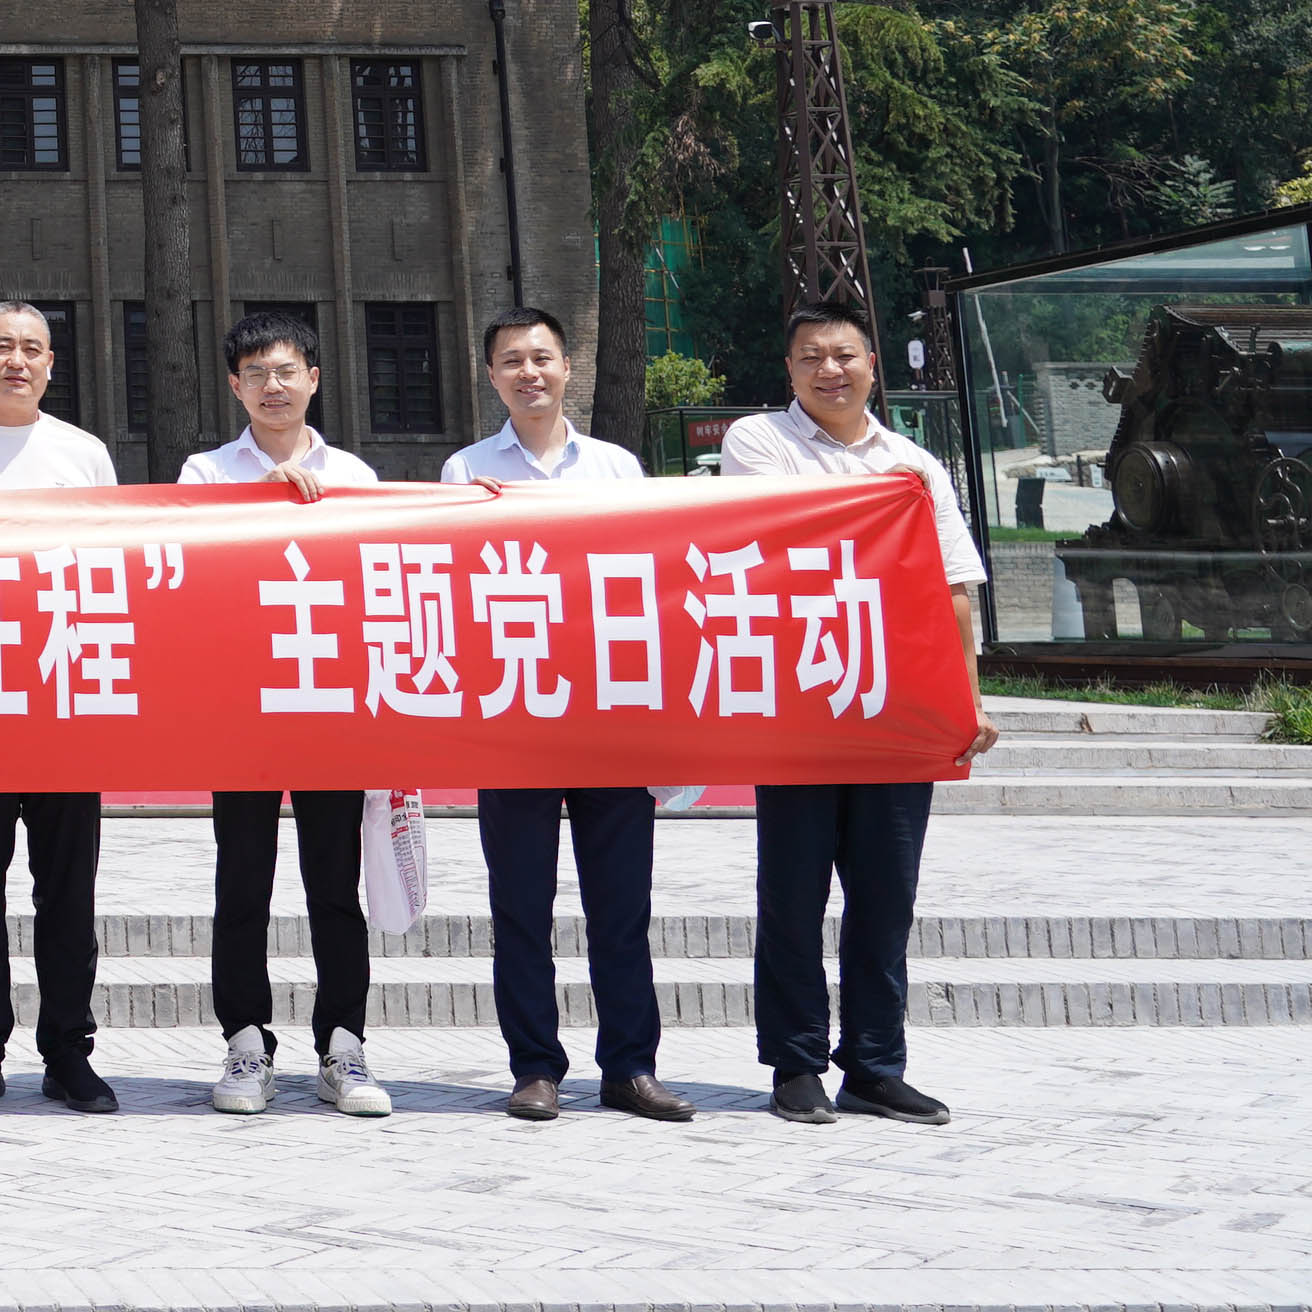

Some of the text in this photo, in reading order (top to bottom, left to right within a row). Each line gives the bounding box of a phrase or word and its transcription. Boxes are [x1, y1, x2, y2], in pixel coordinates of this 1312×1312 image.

[258, 539, 888, 721] 主题党日活动
